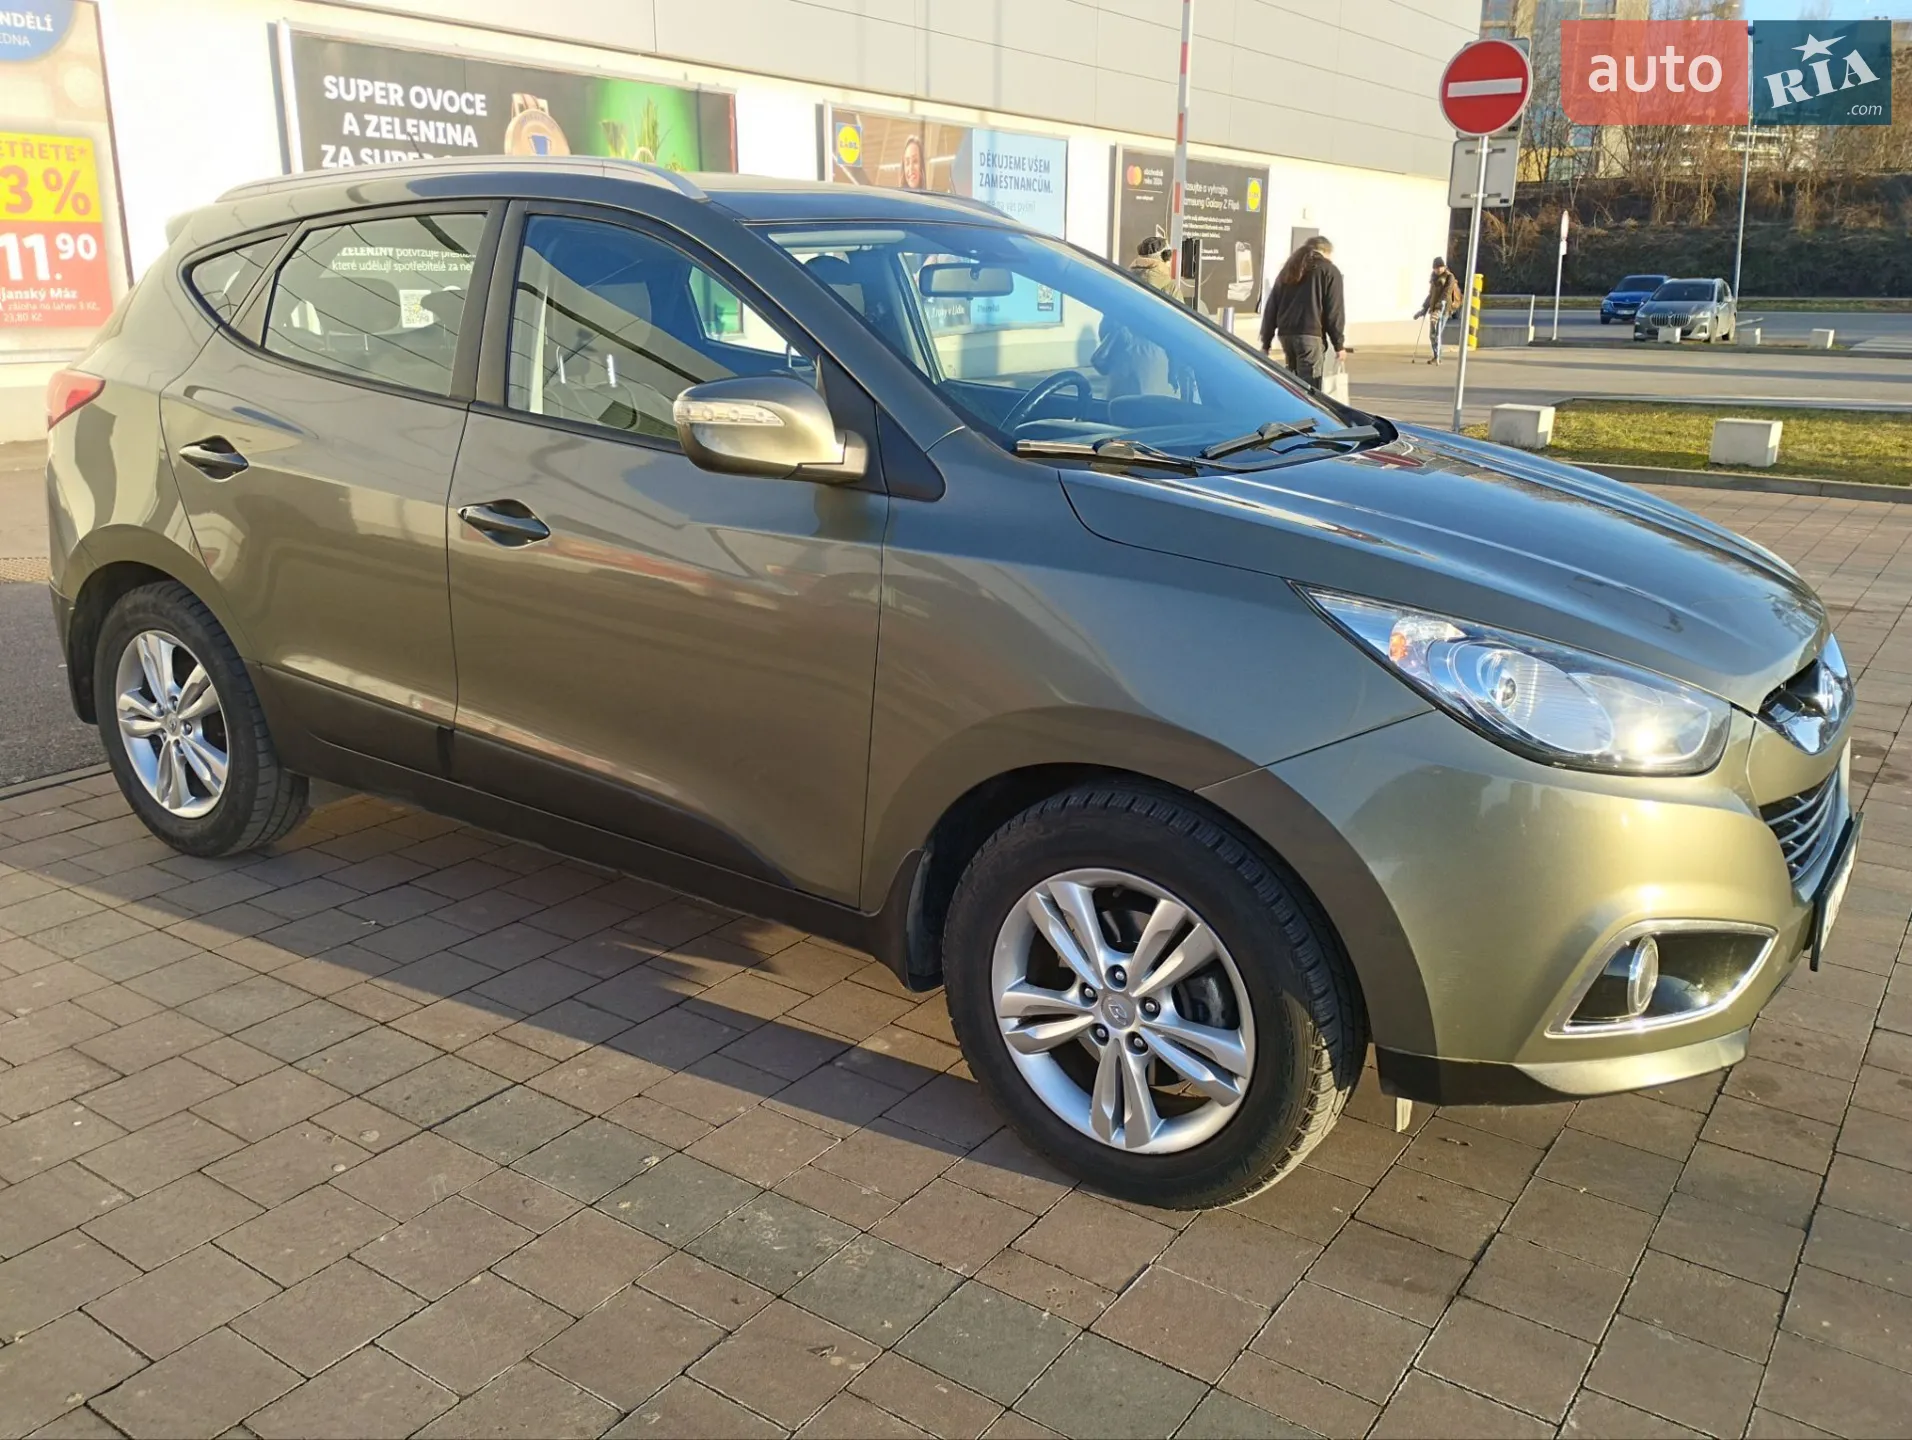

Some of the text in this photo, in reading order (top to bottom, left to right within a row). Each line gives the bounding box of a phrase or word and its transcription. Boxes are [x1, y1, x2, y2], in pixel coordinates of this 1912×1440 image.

[323, 75, 488, 117] SUPER OVOCE
[342, 112, 479, 148] A ZELENINA
[321, 144, 356, 169] ZA
[979, 150, 1050, 175] DĚKUJEME VŠEM
[979, 172, 1053, 194] ZAMĚSTNANCŮM.
[331, 260, 358, 271] které
